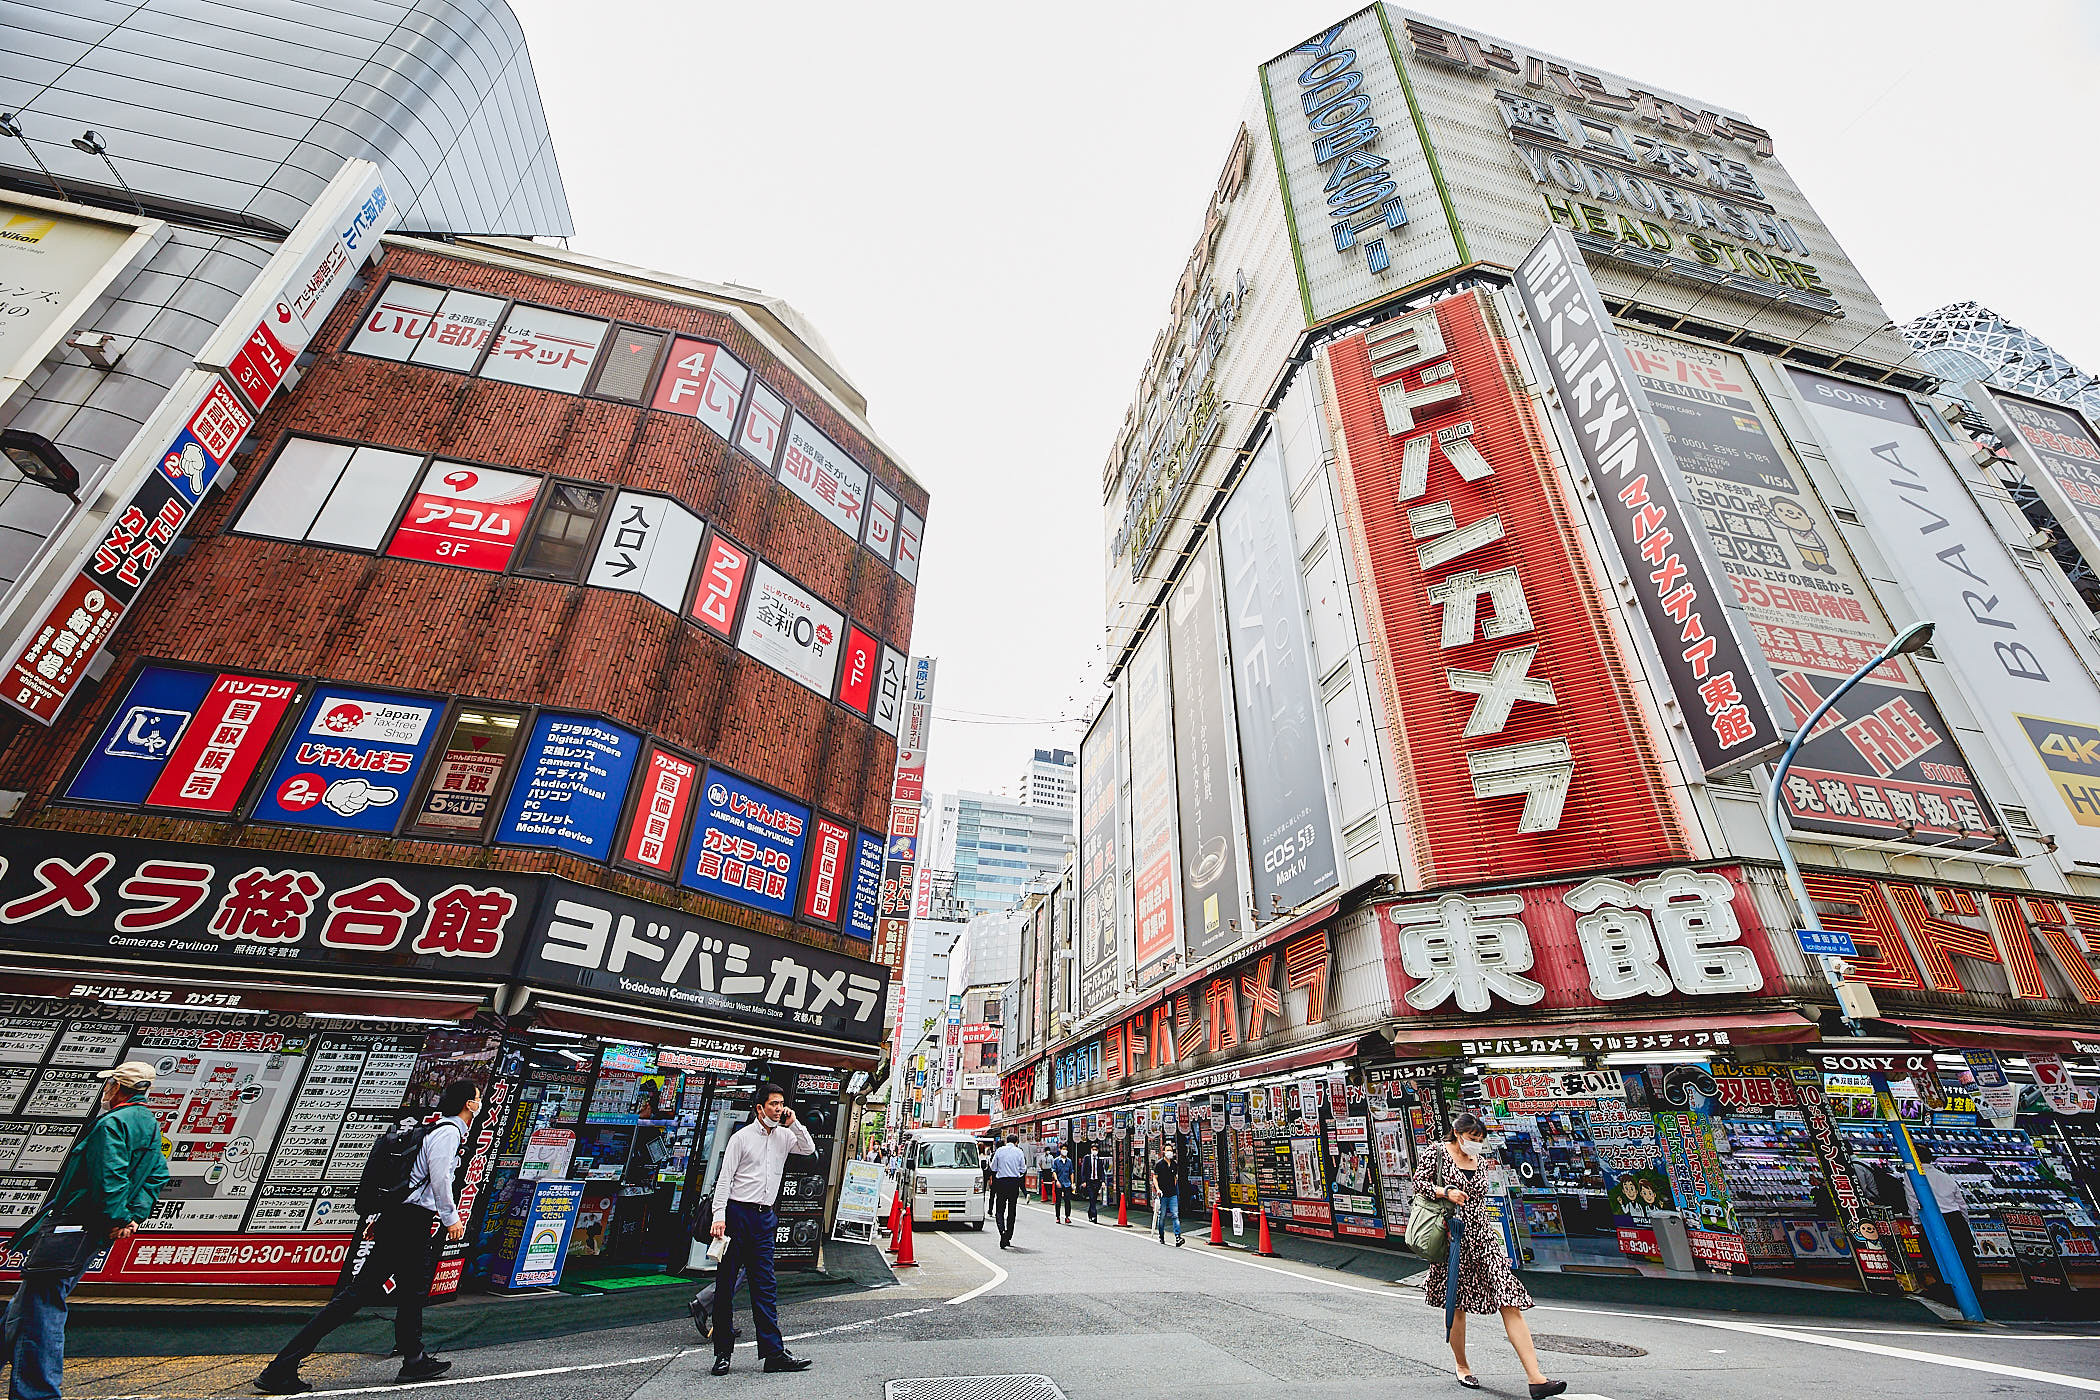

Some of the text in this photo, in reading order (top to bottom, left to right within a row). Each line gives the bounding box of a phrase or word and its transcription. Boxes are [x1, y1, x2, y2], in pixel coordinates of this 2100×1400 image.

[1405, 18, 1773, 158] ヨドバシカメラ
[1296, 22, 1407, 275] YODOBASHI
[1516, 131, 1810, 258] YODOBASHI
[342, 184, 387, 250] 桑原ビル
[0, 231, 40, 244] Nikon
[1546, 195, 1834, 297] HEAD STORE
[367, 309, 592, 369] いい部屋ネット
[1633, 332, 1699, 355] POINT CARD
[252, 330, 283, 377] アコム
[240, 368, 262, 391] 3F
[670, 352, 706, 406] 4F
[1639, 376, 1728, 405] PREMIUM
[214, 385, 248, 427] じゃんばら
[1655, 402, 1695, 416] POINT CARD
[1815, 383, 1888, 410] SONY
[1682, 437, 1708, 450] 0001
[165, 453, 182, 478] 2F
[792, 433, 863, 495] お部屋さがしは
[1131, 380, 1216, 568] HEAD STORE
[1524, 238, 1640, 480] ヨドバシカメラ
[1617, 472, 1756, 751] マルチメディア東館
[1760, 474, 1793, 490] VISA
[415, 503, 511, 537] アコム
[613, 505, 650, 551] 入口
[93, 505, 148, 574] カメラ
[117, 498, 187, 588] ヨドバシ
[435, 541, 470, 557] 3F
[1736, 540, 1788, 567] 火災
[1871, 441, 2050, 683] BRAVIA
[1365, 307, 1575, 835] ヨドバシカメラ
[699, 545, 741, 624] アコム
[761, 591, 794, 619] アコムは
[763, 583, 811, 612] はじめての方なら
[850, 649, 866, 687] 3F
[881, 657, 900, 694] 入口
[914, 660, 930, 700] 桑原ビル
[19, 675, 53, 699] shinkouyo
[218, 680, 290, 699] パソコン!
[372, 717, 417, 731] Tax-free
[375, 706, 422, 723] Japan.
[384, 728, 413, 741] Shop
[547, 734, 622, 757] Digital camera
[550, 722, 620, 745] デジタルカメラ
[1841, 696, 1943, 778] FREE
[180, 699, 260, 800] 買取販売
[295, 743, 412, 775] じゃんばら
[542, 745, 595, 761] 交換レンズ
[535, 767, 589, 782] オーディオ
[540, 757, 607, 777] camera Lens
[656, 754, 692, 778] カメラ!
[898, 772, 922, 782] アコム
[1920, 762, 1971, 785] STORE
[283, 780, 319, 805] 2F
[442, 773, 490, 793] 買取
[528, 788, 572, 803] パソコン
[531, 778, 606, 800] Audio/Visual
[902, 789, 915, 799] 3F
[429, 793, 486, 814] 5%UP
[523, 800, 540, 810] PC
[730, 792, 802, 837] じゃんばら
[1785, 776, 1987, 832] 免税品取扱店
[520, 811, 574, 826] タブレット
[638, 770, 680, 864] 高価買取
[710, 810, 794, 847] JANPARA SHINJYUKU02
[516, 822, 593, 844] Mobile device
[819, 822, 849, 841] パソコン!
[703, 828, 790, 873] カメラ・PC
[1264, 836, 1295, 873] EOS
[697, 851, 787, 900] 高価買取
[813, 836, 839, 917] 高価買取
[1276, 863, 1298, 886] Mark
[1298, 856, 1307, 874] IV
[883, 879, 899, 914] カメラ
[896, 865, 914, 911] ヨドバシ
[917, 870, 931, 915] カラオケ
[0, 851, 517, 958] メラ総合館
[854, 901, 863, 909] PC
[109, 934, 166, 949] Cameras
[168, 938, 219, 953] Pavilion
[1390, 868, 1763, 1012] 東館
[1803, 933, 1848, 944] 一番街通り
[541, 899, 881, 1022] ヨドバシカメラ
[69, 984, 241, 1006] ヨドバシカメラ カメラ館
[619, 977, 823, 1026] Yodobashi Camera Shinjuku West Main Store 友都八喜
[1105, 929, 1330, 1081] ヨドバシカメラ
[138, 1026, 203, 1038] ヨドバシカメラ
[142, 1037, 199, 1048] 新宿西口本店
[199, 1031, 284, 1051] 全館案内
[1462, 1031, 1730, 1056] ヨドバシカメラ マルチメディア館
[690, 1037, 780, 1059] ヨドバシカメラ カメラ館
[1055, 1041, 1101, 1089] 新宿西口
[1371, 1064, 1448, 1081] ヨドバシカメラ
[1823, 1056, 1928, 1071] SONY α
[1483, 1075, 1555, 1098] 10% ポイント
[1524, 1086, 1549, 1098] 還元
[284, 1136, 327, 1146] パソコン本体
[288, 1124, 325, 1134] オーディオ
[1592, 1125, 1655, 1139] ヨドバシカメラ
[28, 1144, 67, 1153] ガシャポン
[1598, 1145, 1662, 1159] アフターサービス
[1677, 1115, 1707, 1196] ヨドバシカメラ
[783, 1187, 797, 1196] R6
[255, 1209, 305, 1217] 自転車・お酒
[776, 1232, 789, 1243] R5
[134, 1246, 211, 1265] 営業時間
